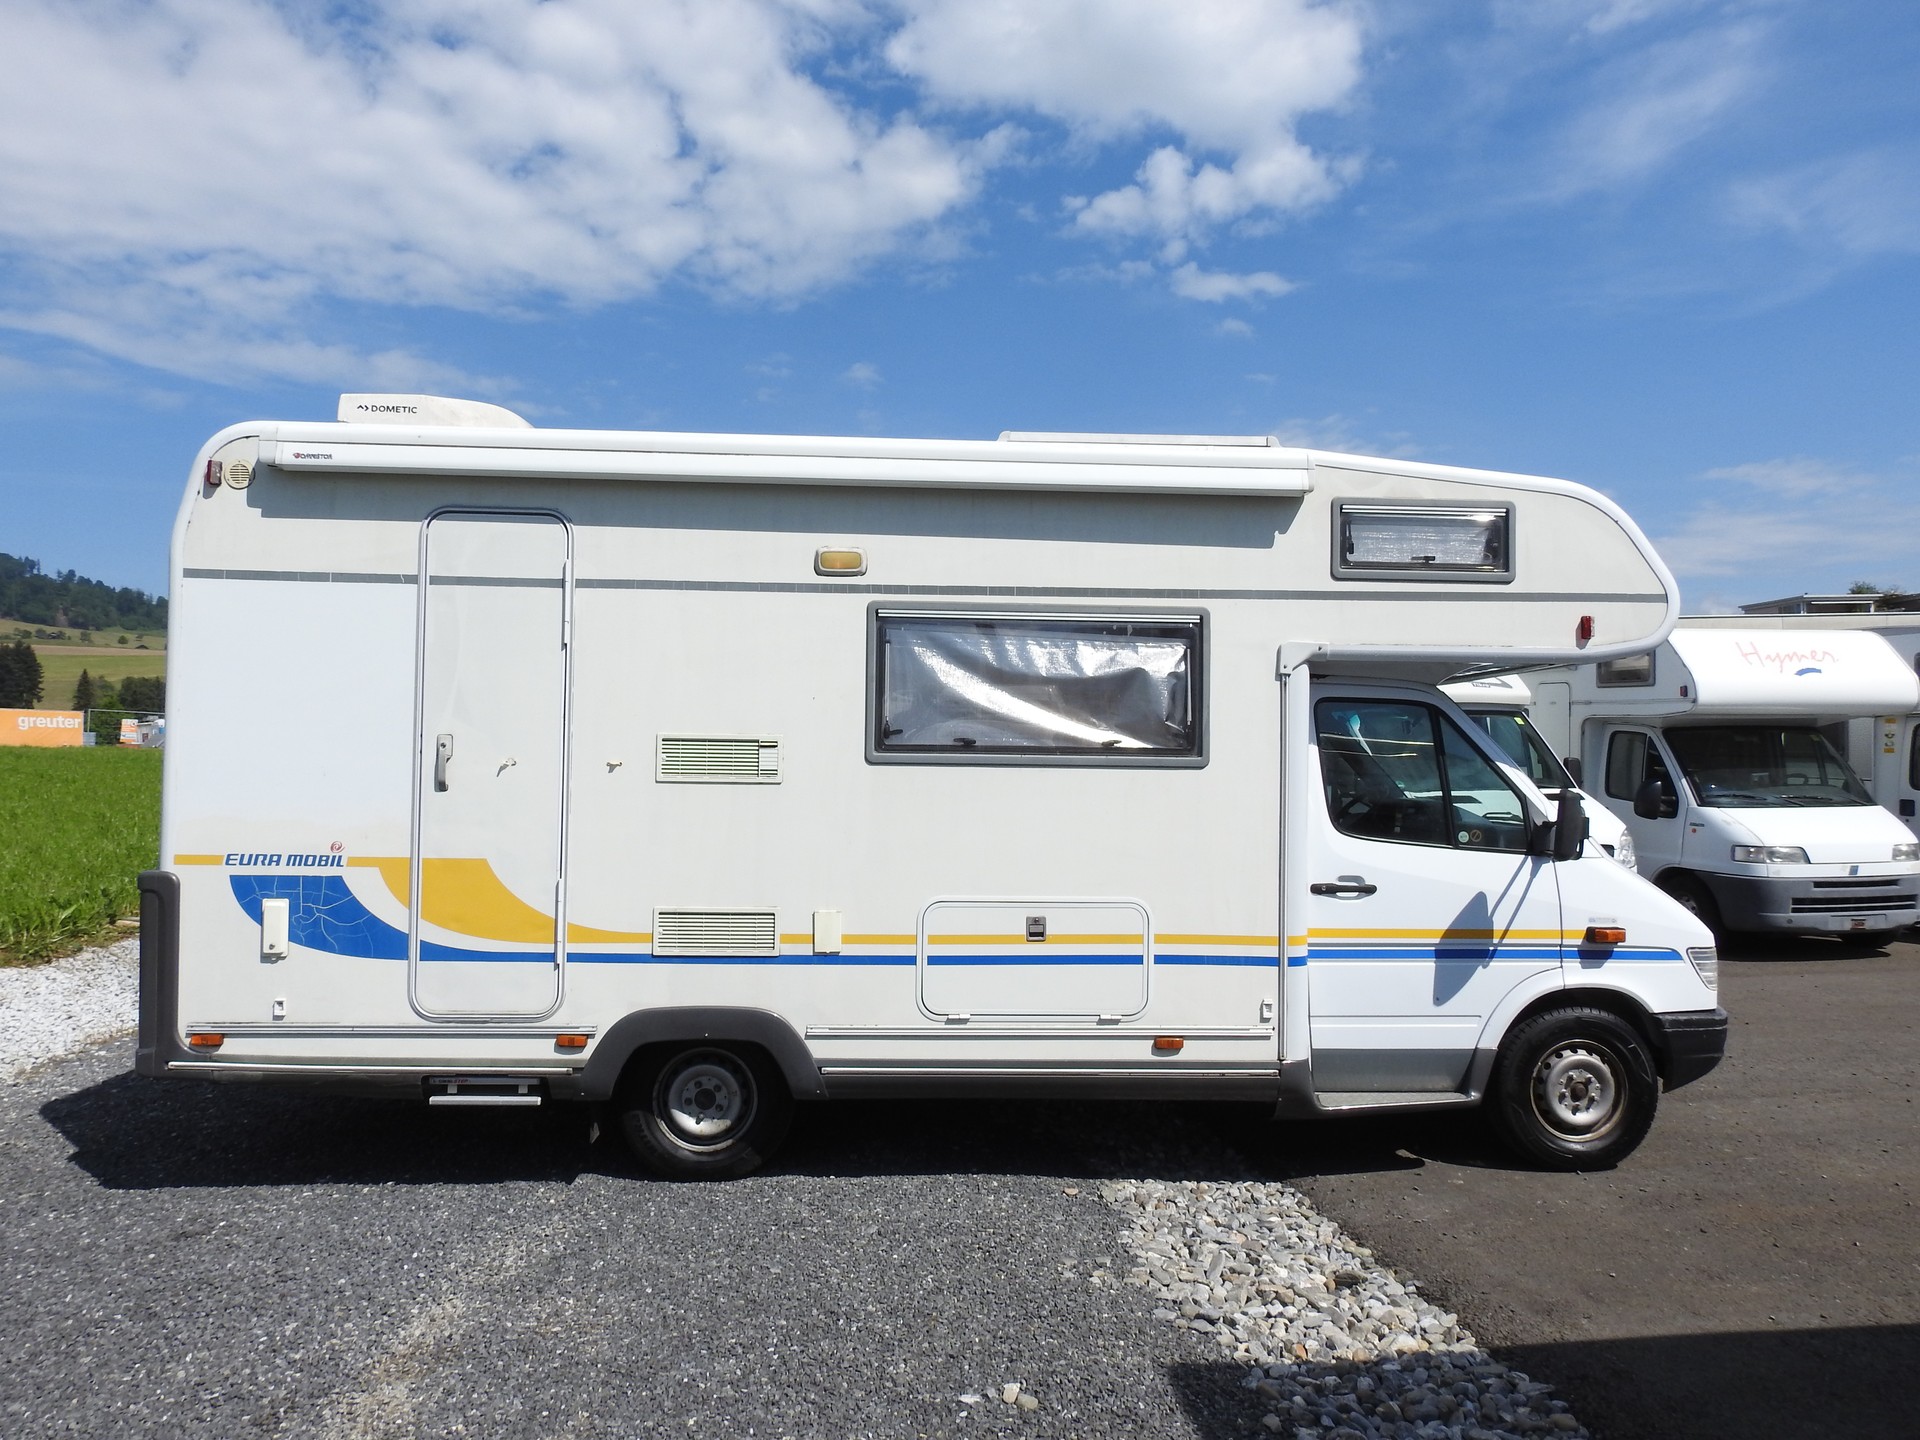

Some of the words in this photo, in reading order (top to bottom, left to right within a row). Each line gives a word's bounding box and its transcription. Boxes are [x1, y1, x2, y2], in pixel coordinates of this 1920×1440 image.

[371, 404, 418, 414] DOMETIC
[1735, 641, 1836, 674] Hymer
[18, 716, 81, 730] greuter
[225, 853, 282, 867] EURA
[285, 854, 344, 868] MOBIL
